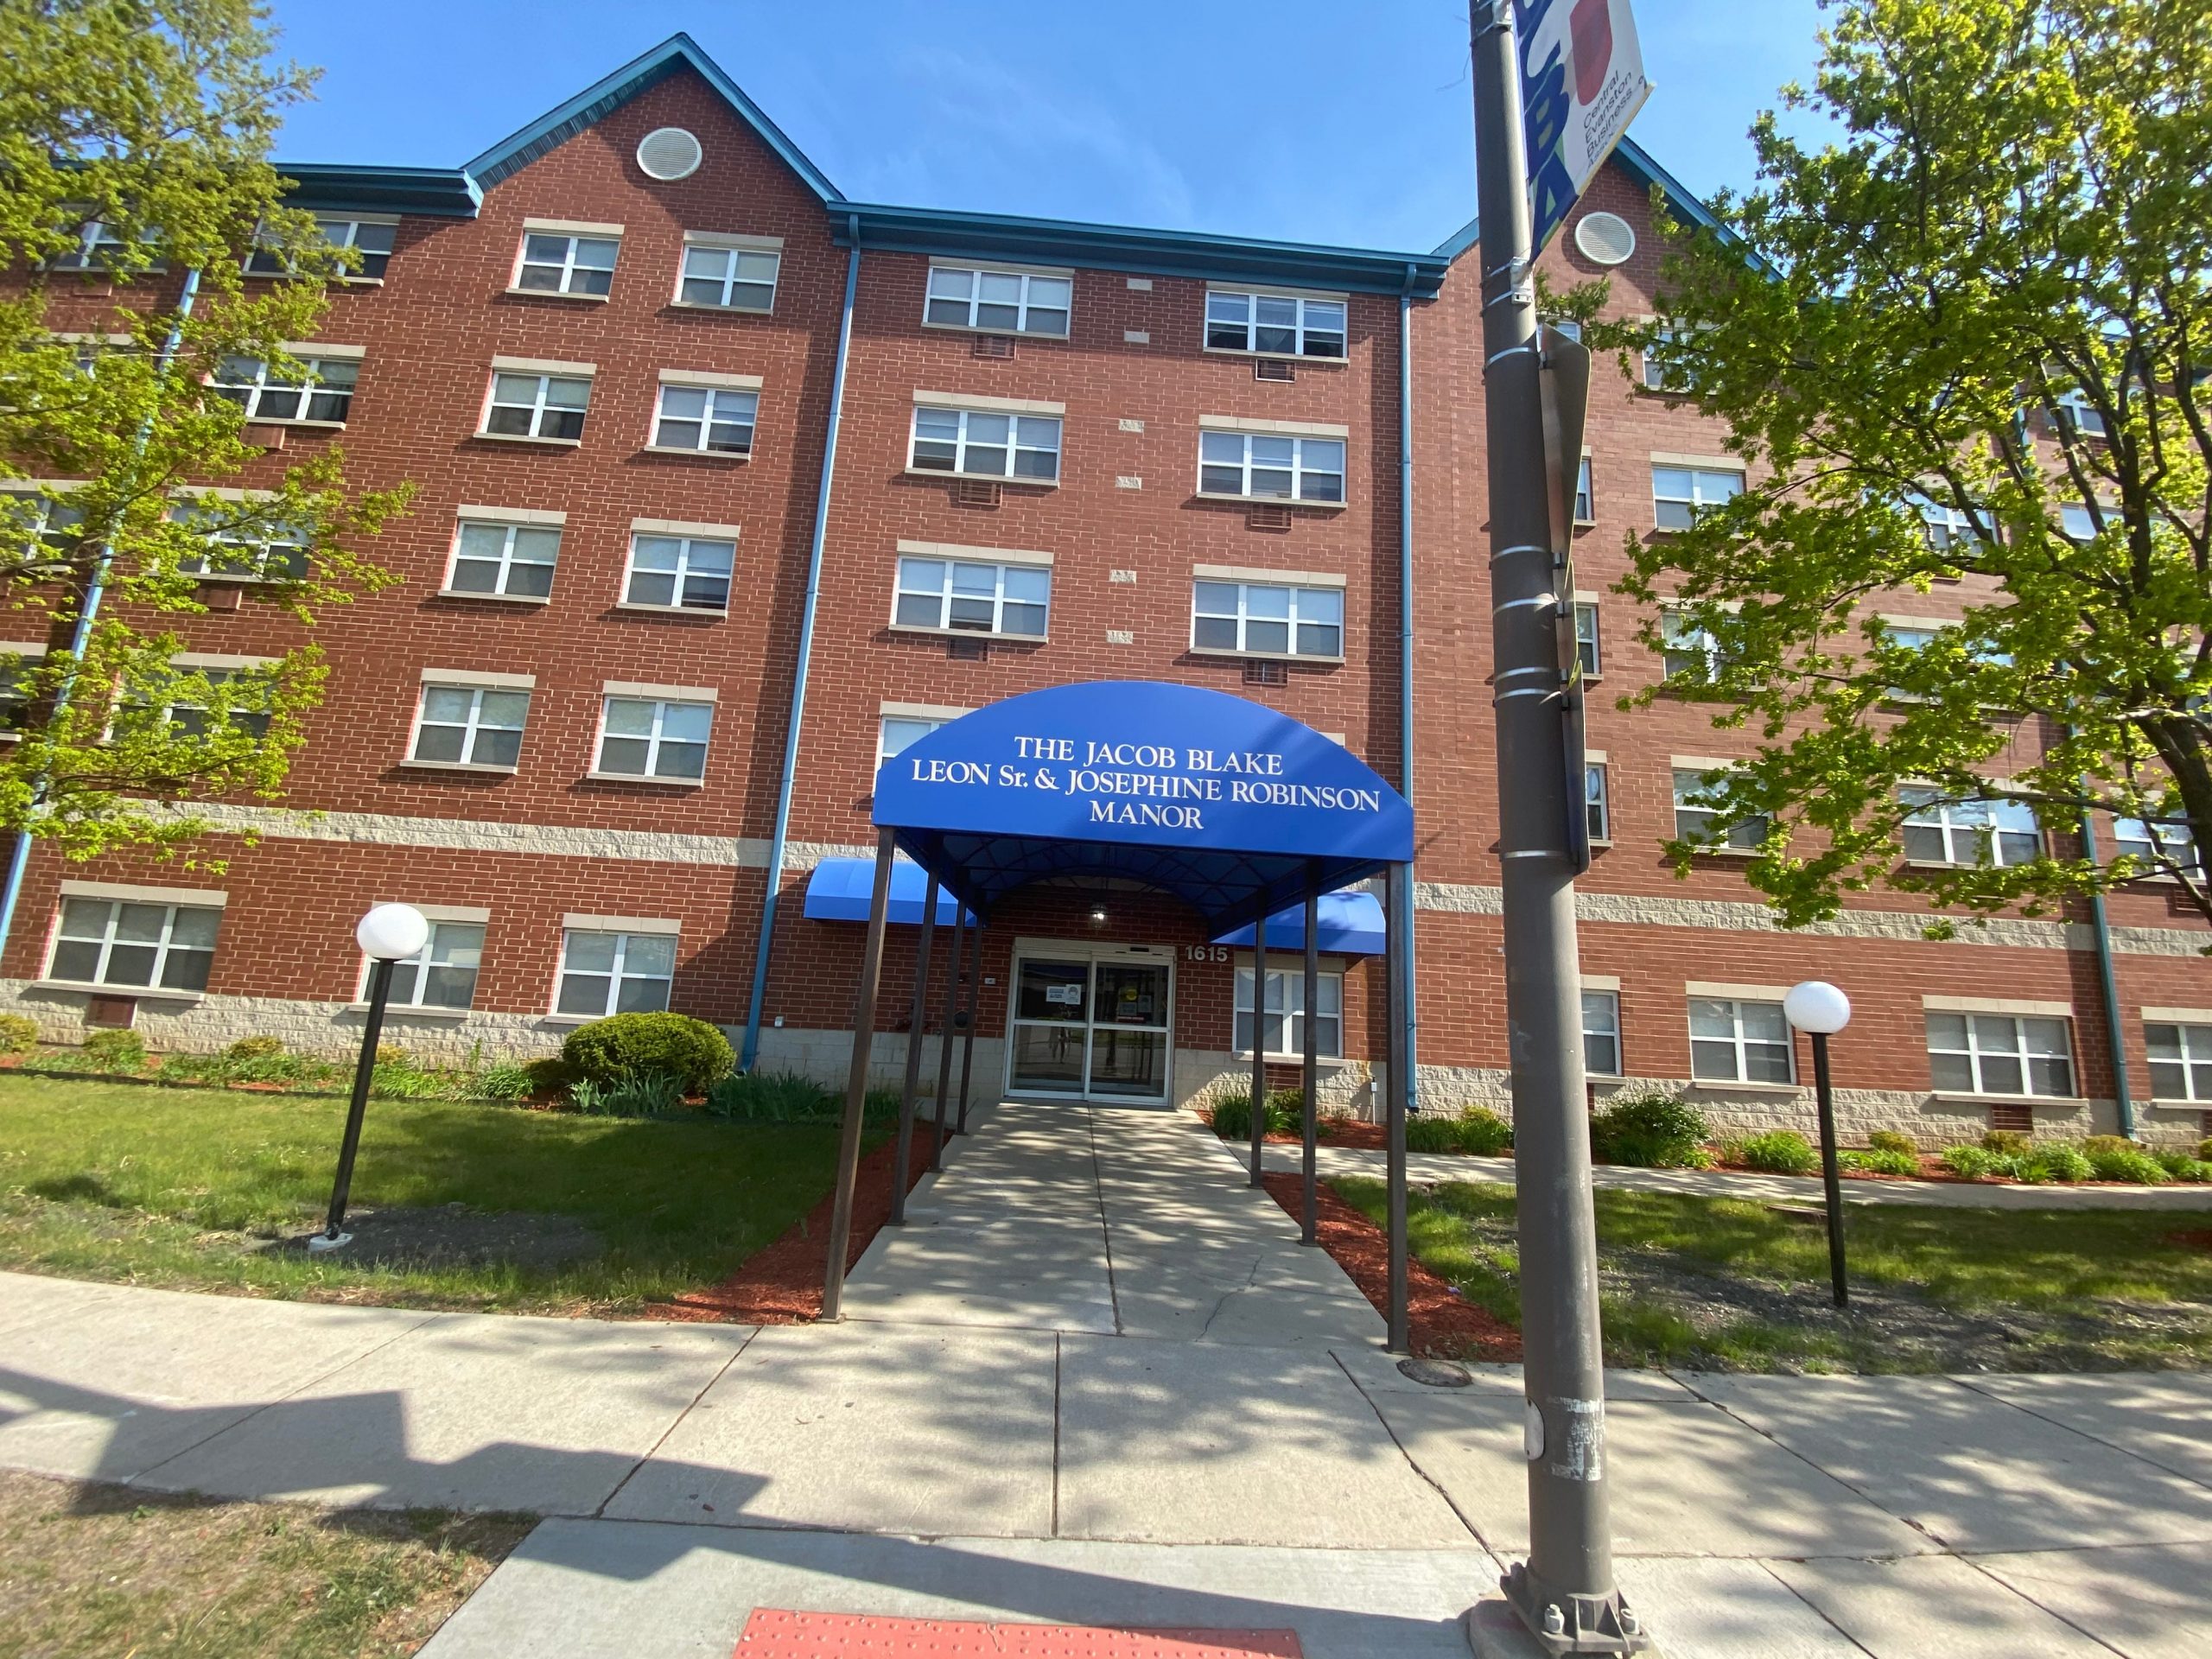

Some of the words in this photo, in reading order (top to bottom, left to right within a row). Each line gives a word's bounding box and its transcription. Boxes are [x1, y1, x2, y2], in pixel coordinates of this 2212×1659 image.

[1583, 69, 1619, 129] Central
[1585, 71, 1632, 143] Evanston
[1586, 87, 1632, 158] Business
[1014, 736, 1075, 761] THE
[1083, 741, 1176, 769] JACOB
[1186, 748, 1283, 776] BLAKE
[912, 759, 992, 785] LEON
[999, 765, 1028, 788] Sr.
[1034, 767, 1059, 790] &
[1065, 770, 1224, 802] JOSEPHINE
[1231, 780, 1380, 813] ROBINSON
[1089, 800, 1204, 830] MANOR
[1185, 944, 1228, 963] 1615
